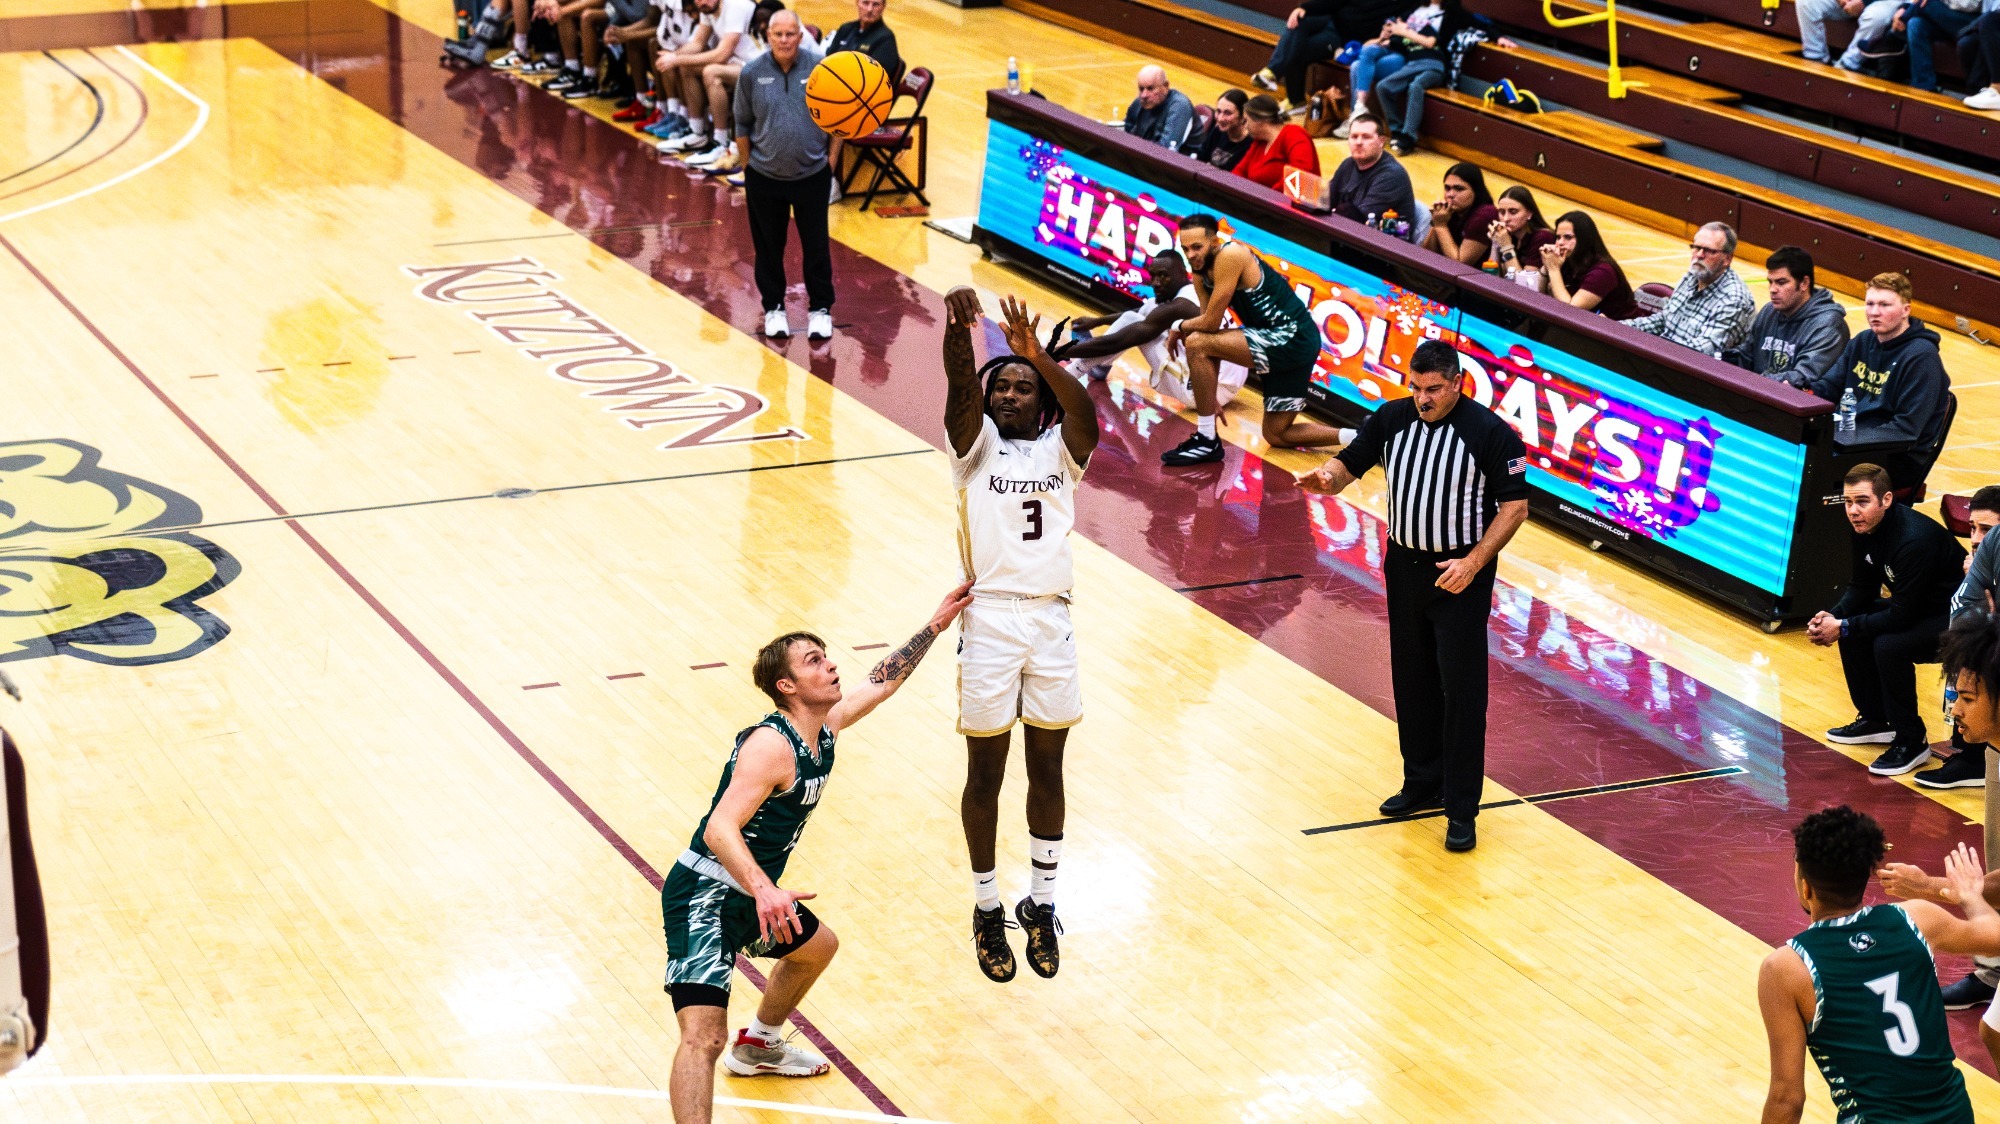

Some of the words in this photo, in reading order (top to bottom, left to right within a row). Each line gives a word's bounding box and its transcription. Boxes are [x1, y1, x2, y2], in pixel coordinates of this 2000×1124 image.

[1688, 54, 1699, 72] C
[1536, 152, 1546, 168] A
[1055, 183, 1188, 272] HAP
[403, 255, 809, 450] KUTZTOWN
[988, 471, 1065, 494] KUTZTOWN
[1022, 499, 1043, 541] 3
[1863, 970, 1921, 1057] 3
